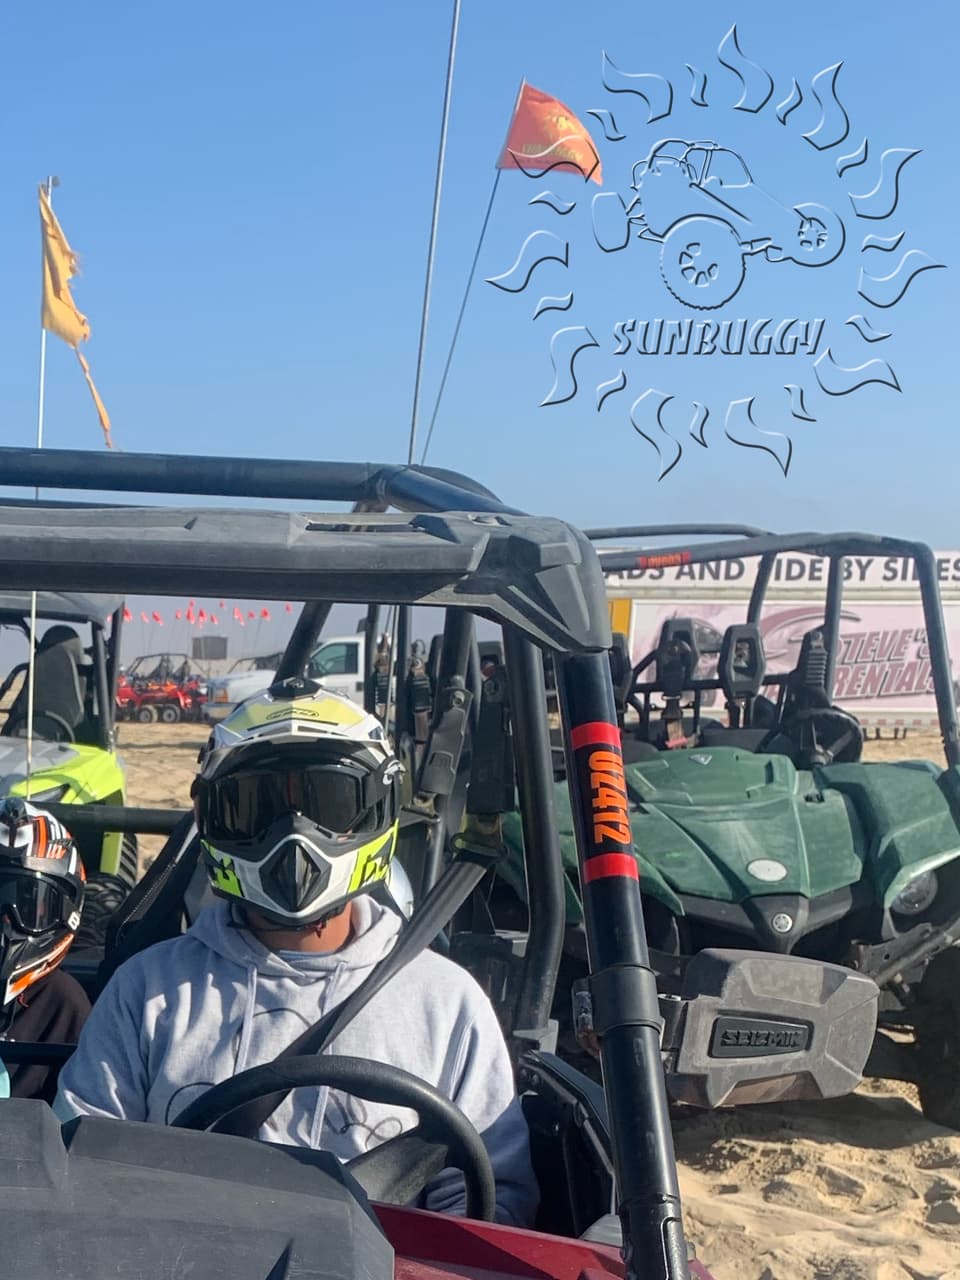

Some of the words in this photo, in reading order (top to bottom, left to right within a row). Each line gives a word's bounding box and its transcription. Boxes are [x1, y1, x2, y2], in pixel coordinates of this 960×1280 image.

[675, 557, 744, 580] AND
[758, 557, 823, 581] IDE
[841, 557, 872, 581] BY
[836, 629, 931, 665] TEVE'
[589, 751, 631, 844] UZ412
[720, 1029, 801, 1047] SEIZMIK
